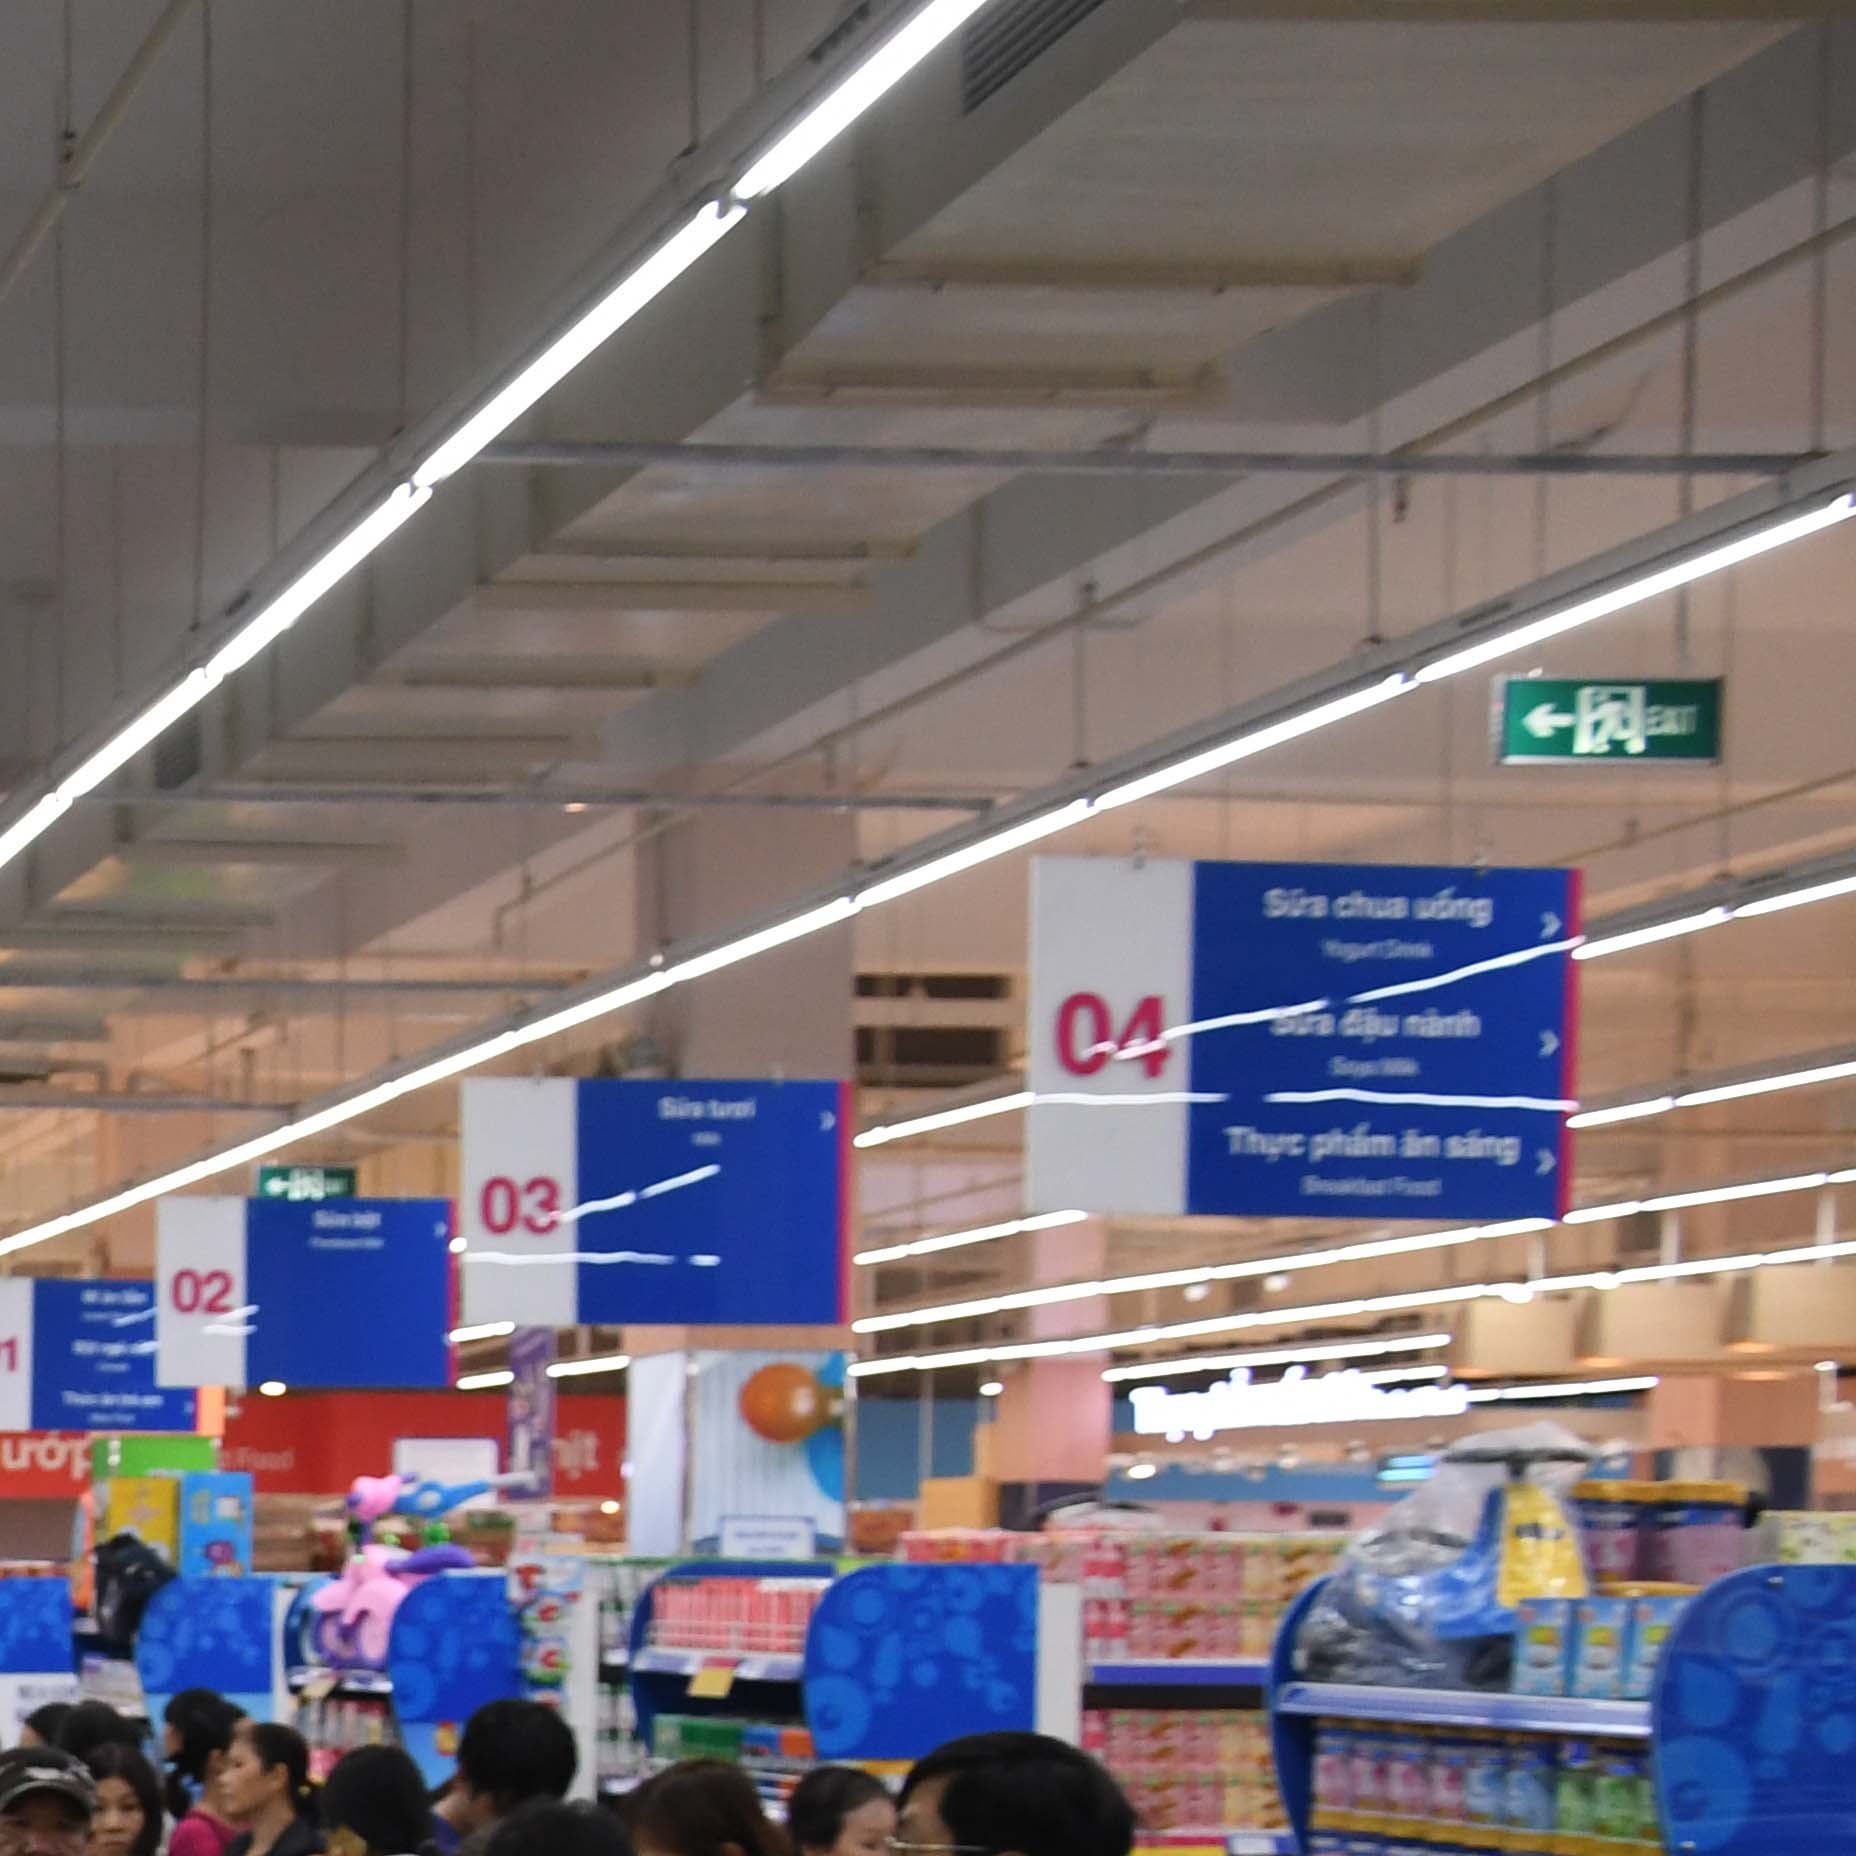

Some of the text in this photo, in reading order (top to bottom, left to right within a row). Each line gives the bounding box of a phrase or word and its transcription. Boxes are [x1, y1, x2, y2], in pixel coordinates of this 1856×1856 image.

[1334, 890, 1410, 920] chua
[1054, 990, 1170, 1079] 04
[481, 1176, 561, 1236] 03
[172, 1268, 232, 1315] 02
